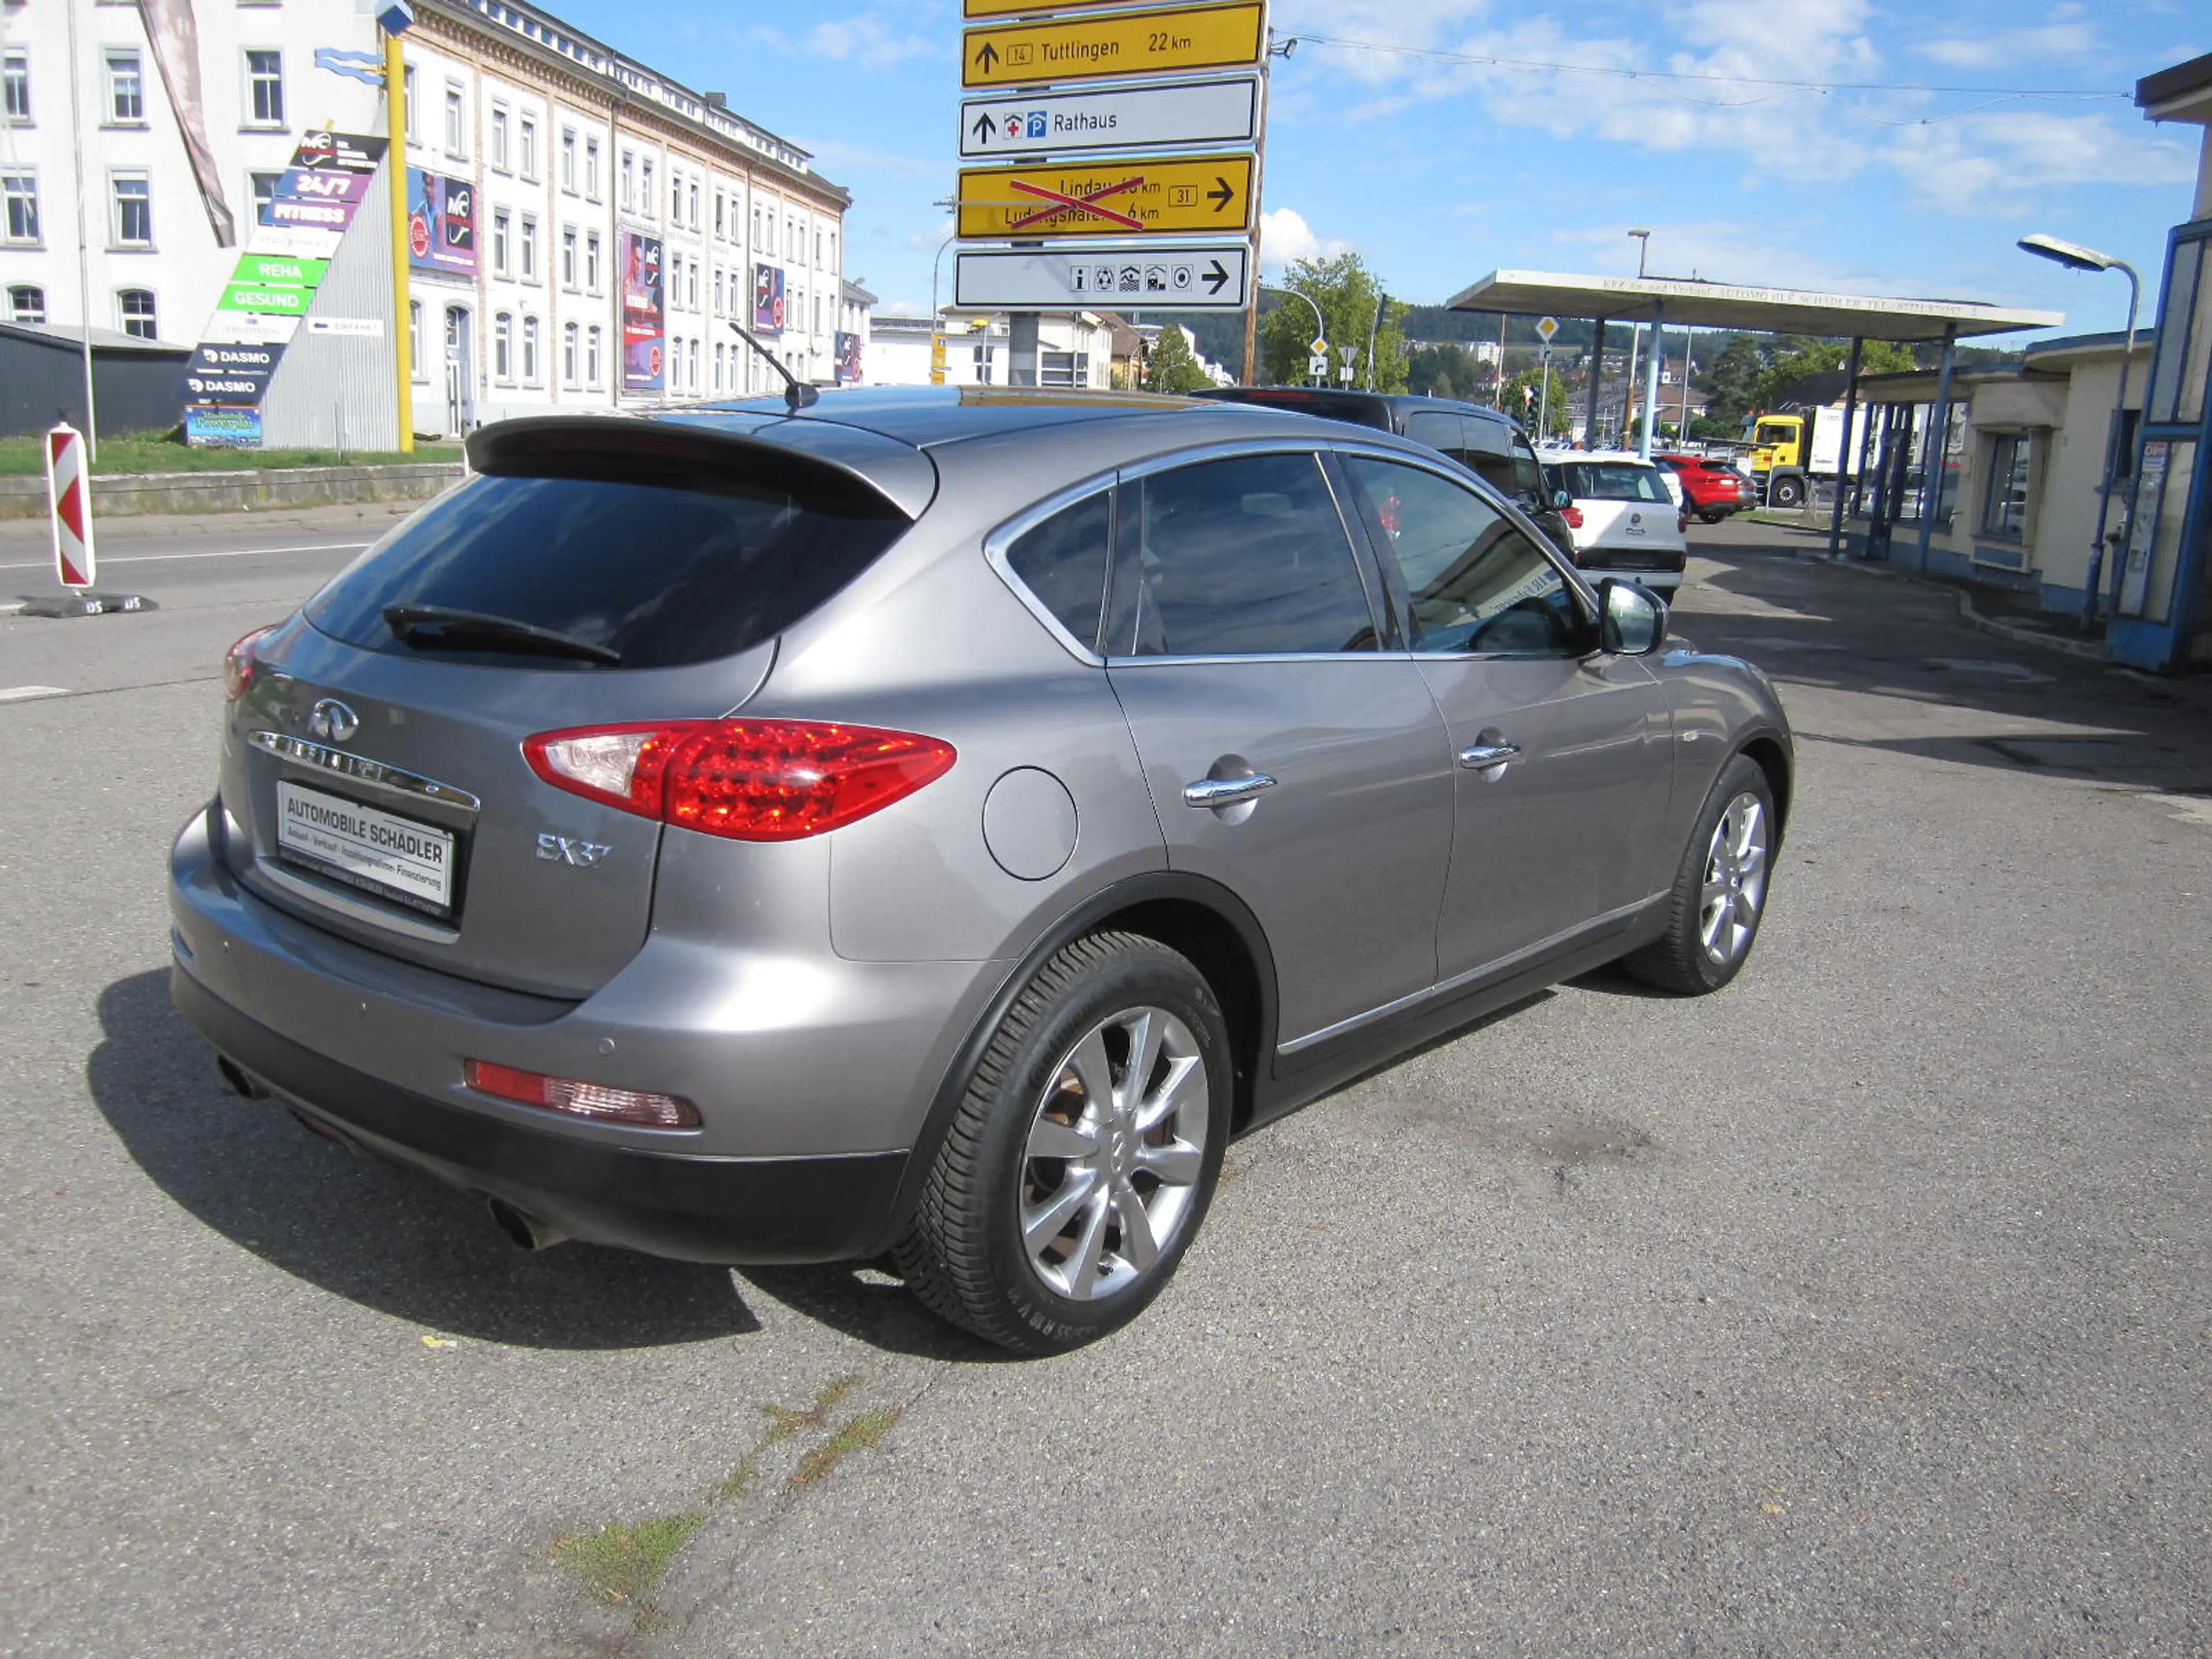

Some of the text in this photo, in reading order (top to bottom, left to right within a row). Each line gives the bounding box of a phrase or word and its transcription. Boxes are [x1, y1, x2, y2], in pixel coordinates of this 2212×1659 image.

[1013, 33, 1191, 62] 14 Tuttlingen 22 km
[1054, 113, 1118, 132] Rathaus
[297, 175, 352, 196] 24/7
[1141, 181, 1161, 194] km
[1176, 190, 1190, 203] 31
[274, 204, 346, 224] FITNESS
[1005, 202, 1160, 227] Ludgshafe 6 km
[258, 263, 303, 278] REHA
[234, 291, 299, 308] GESUND
[220, 350, 270, 364] DASMO
[205, 380, 256, 393] DASMO
[287, 797, 442, 863] AUTOMOBILE SCHÄDLER
[536, 833, 613, 866] EX37
[396, 864, 442, 891] Finanzierung
